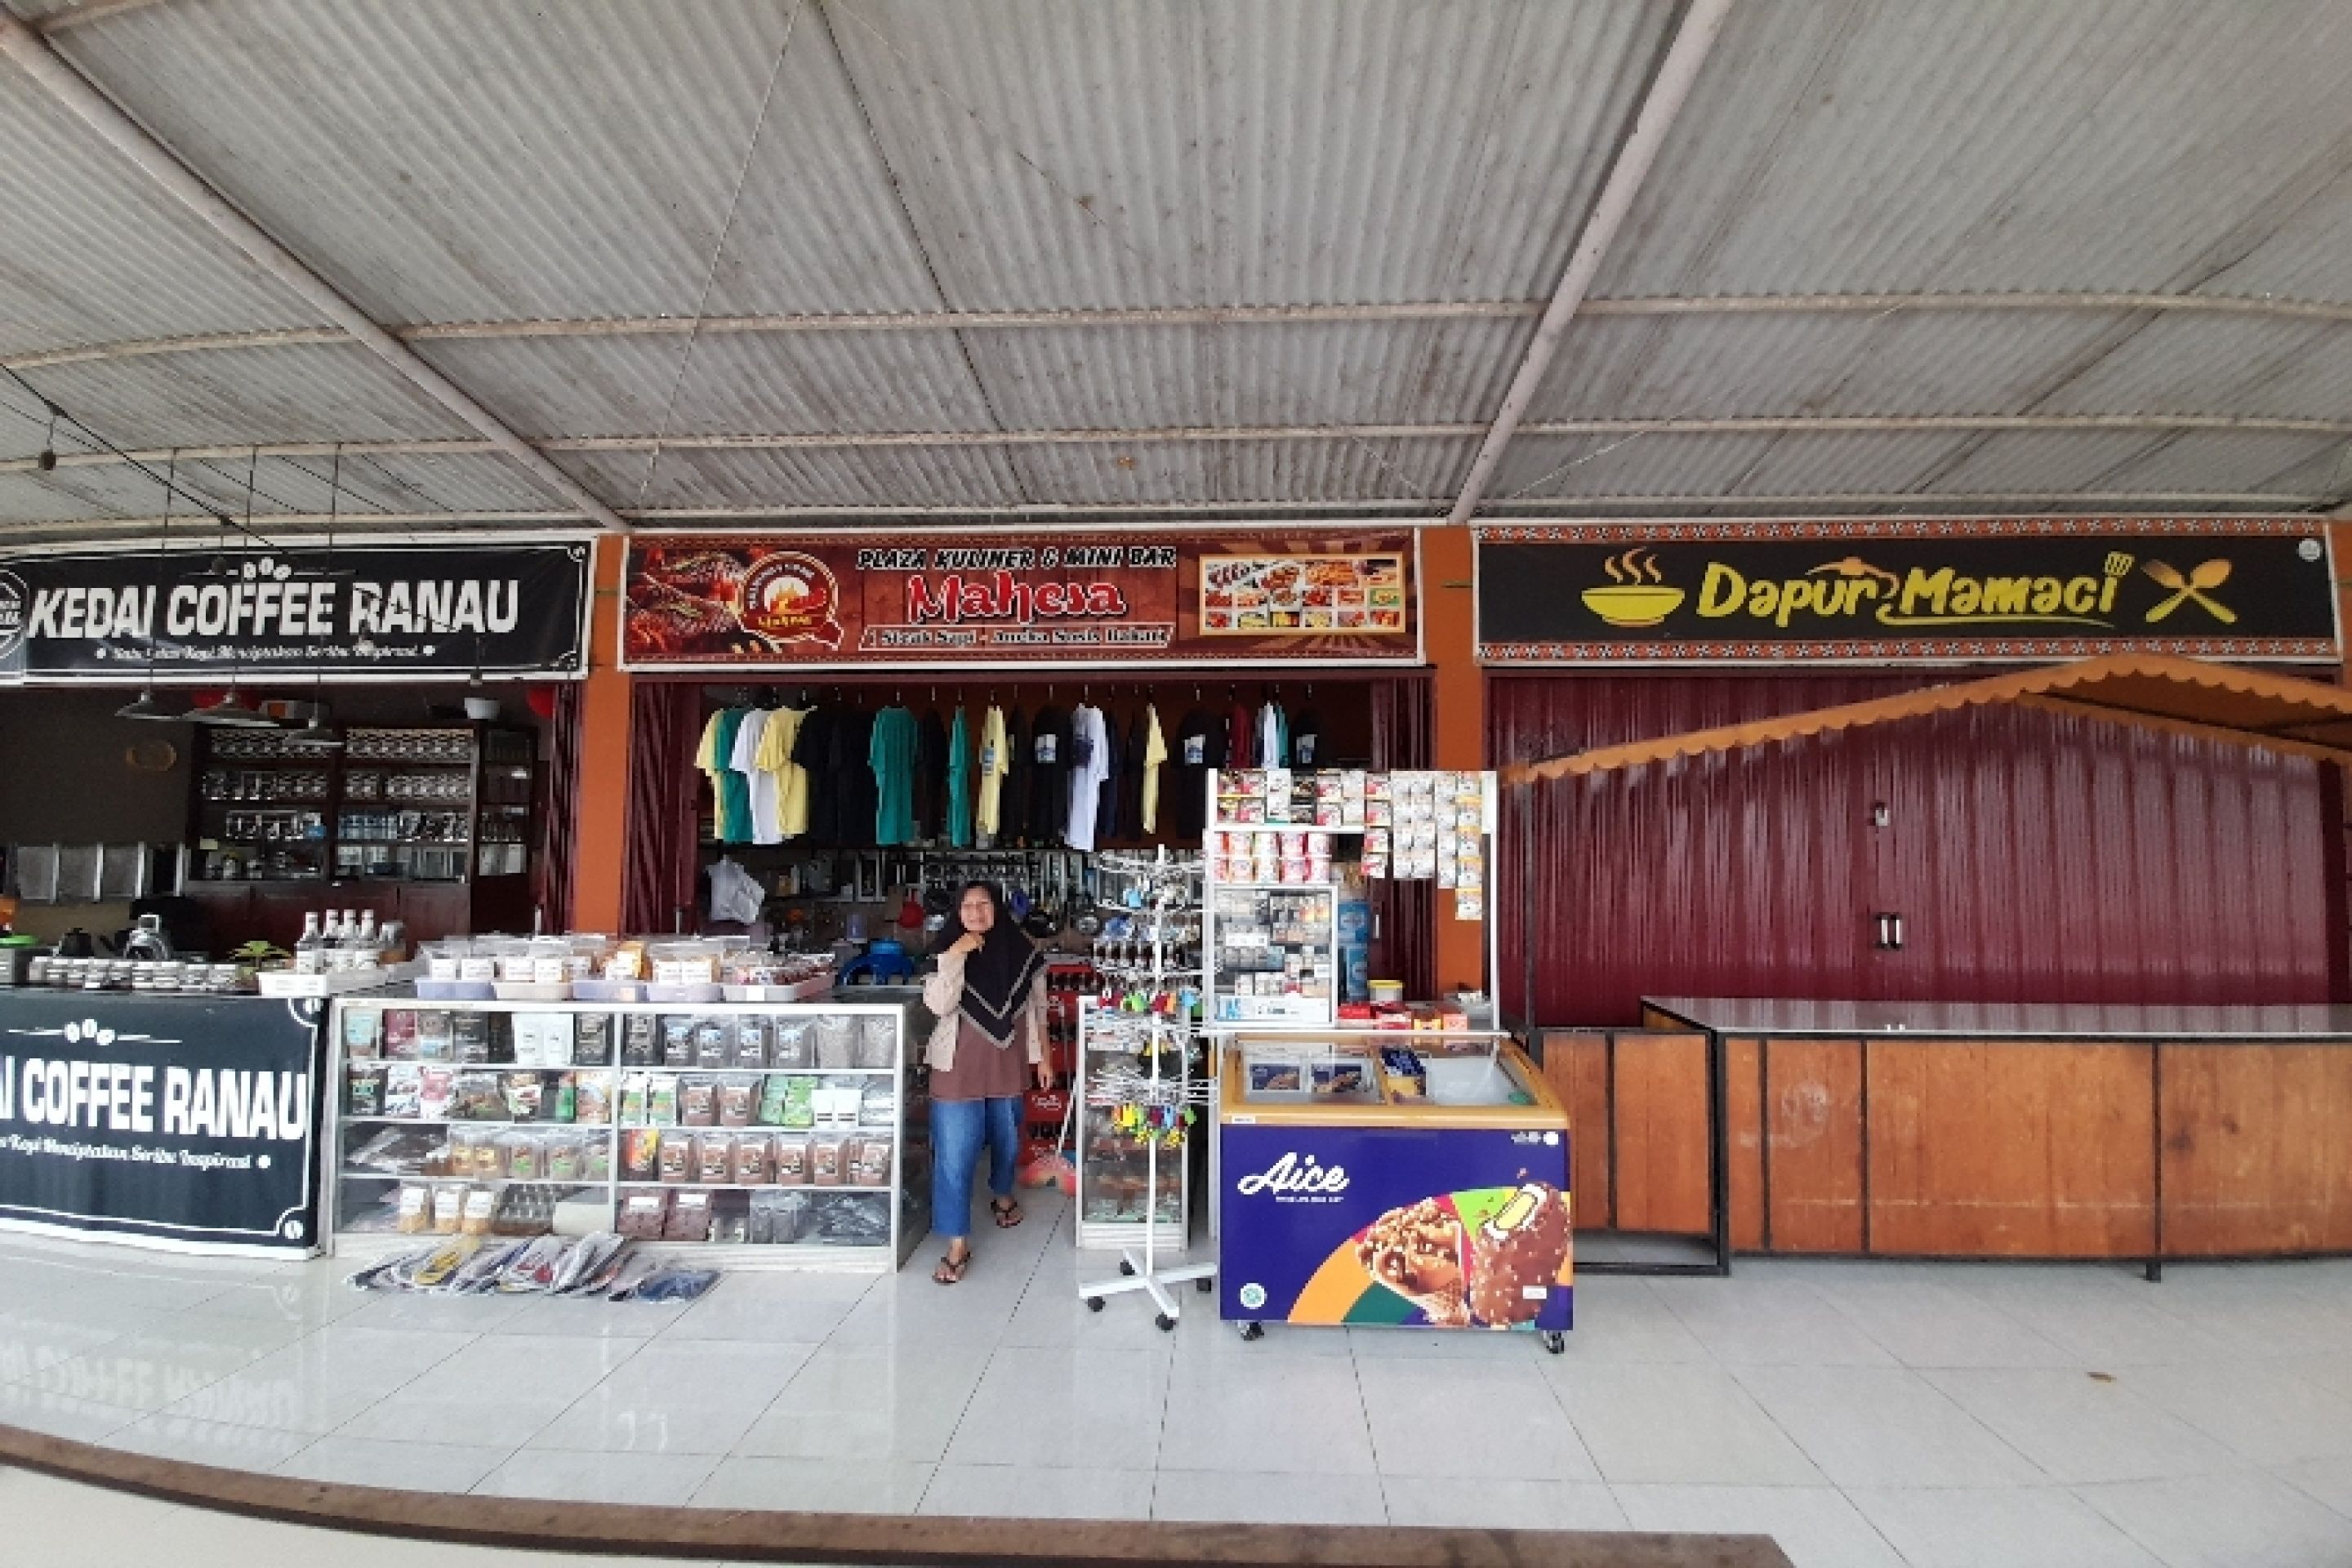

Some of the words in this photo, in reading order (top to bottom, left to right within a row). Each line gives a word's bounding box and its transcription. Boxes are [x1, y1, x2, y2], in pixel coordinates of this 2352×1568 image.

[857, 548, 927, 569] PLAZA
[934, 548, 1036, 569] KULINER
[1064, 546, 1124, 568] MINI
[1129, 546, 1177, 567] BAR
[29, 586, 157, 639] KEDAI
[167, 582, 336, 635] COFFEE
[350, 579, 519, 633] RANAU
[908, 571, 1128, 625] Mahesa
[1696, 561, 1878, 628] Dapur
[1900, 551, 2135, 614] Mamaci
[23, 1058, 155, 1133] COFFEE
[163, 1066, 306, 1140] RANAU
[1237, 1152, 1350, 1195] Aice
